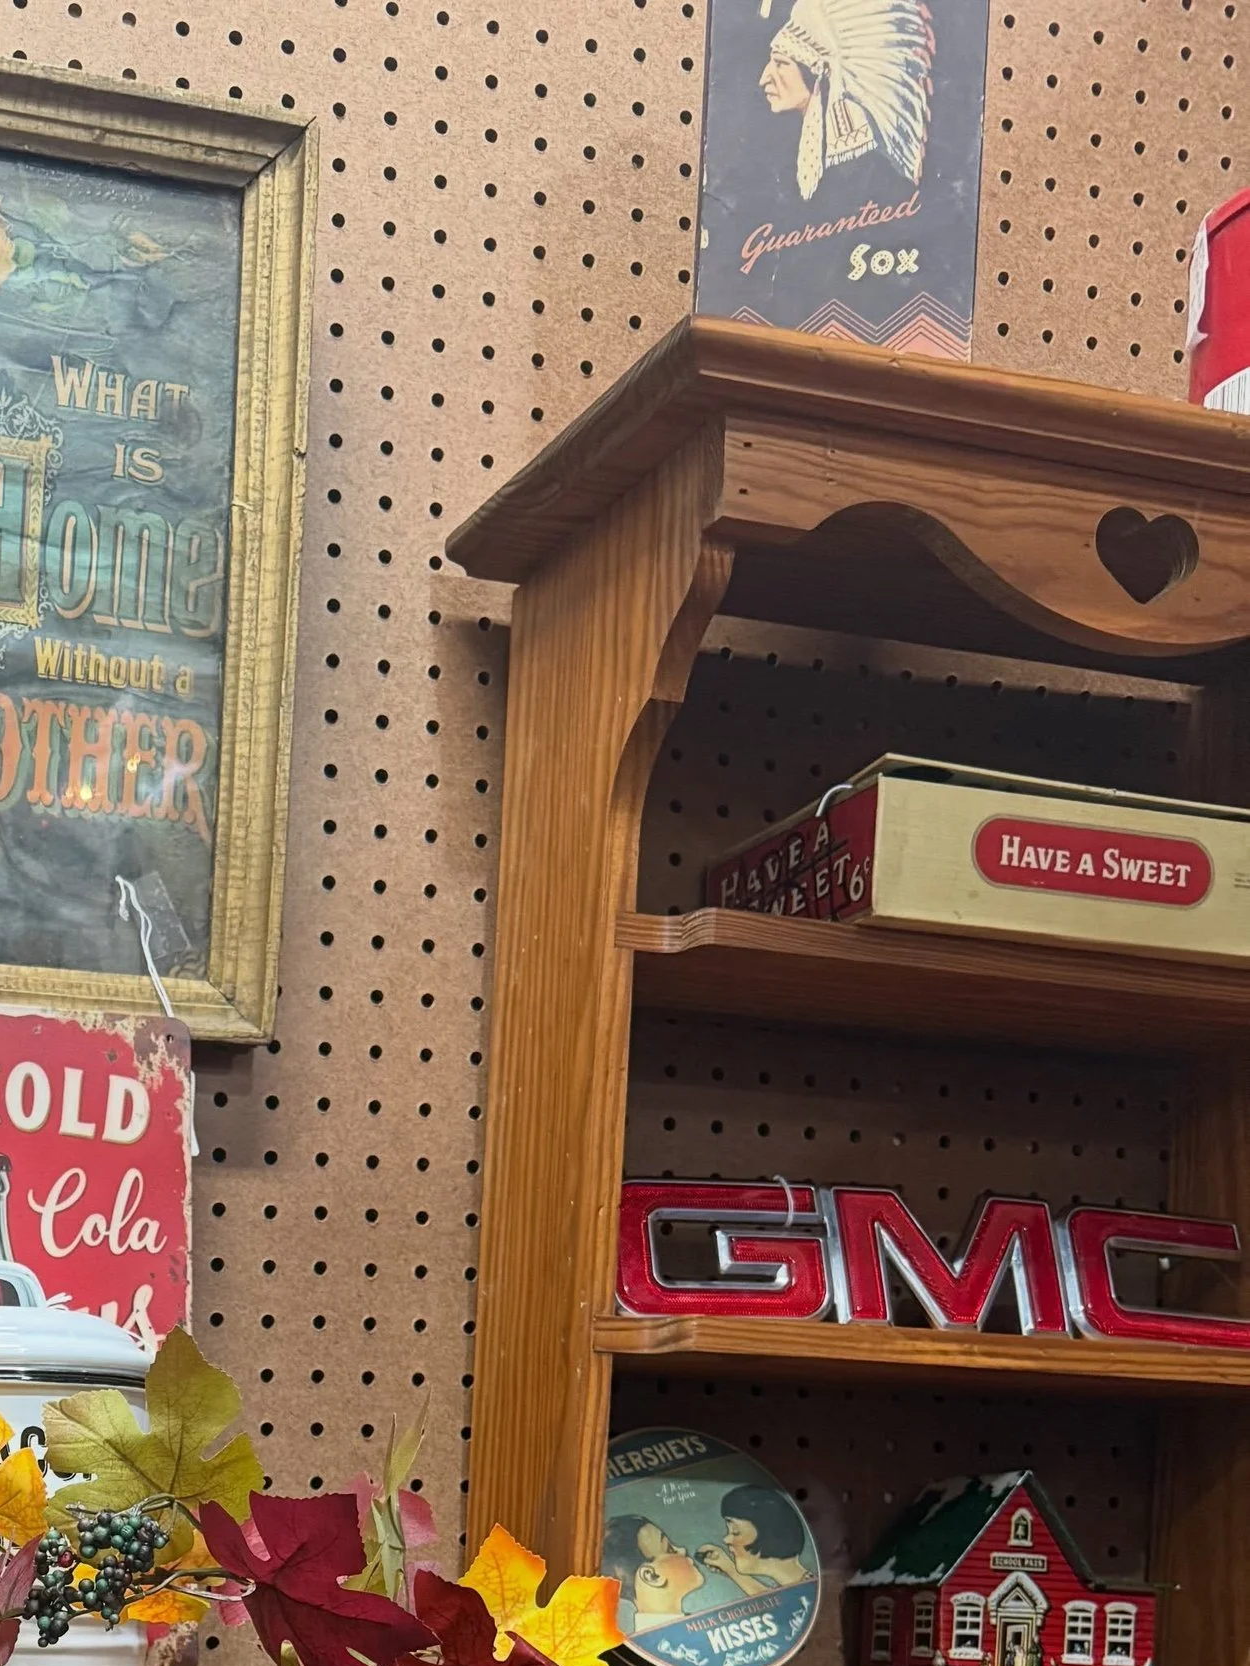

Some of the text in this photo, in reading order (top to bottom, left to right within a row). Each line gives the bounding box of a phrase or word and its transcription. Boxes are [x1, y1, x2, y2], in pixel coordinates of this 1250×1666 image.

[740, 190, 922, 274] Guaranteed
[113, 442, 165, 484] IS
[34, 639, 197, 697] Without a
[813, 821, 829, 852] A
[27, 1167, 168, 1257] Cola
[614, 1178, 1250, 1348] GMC
[706, 1613, 780, 1655] KISSES
